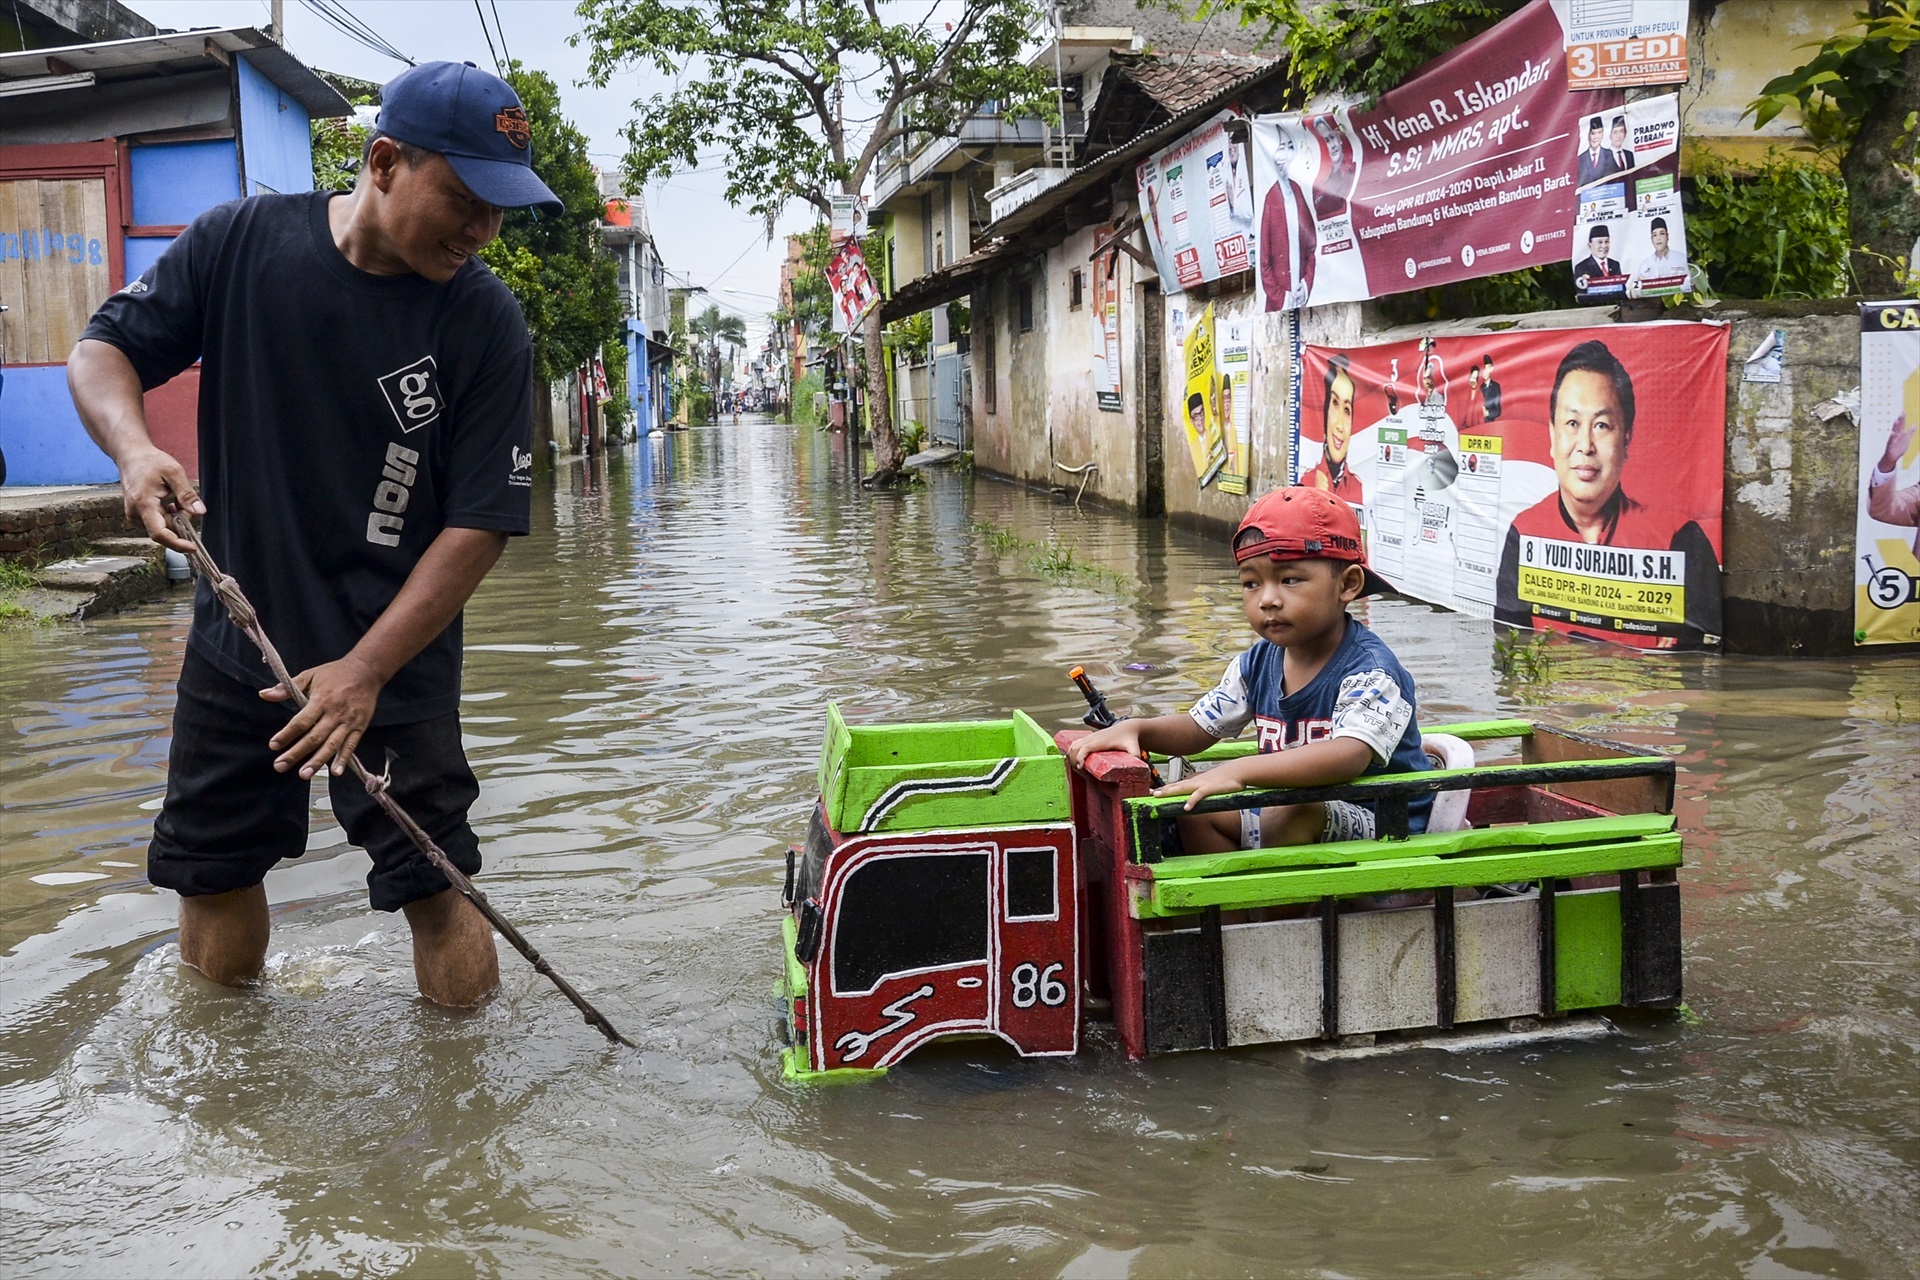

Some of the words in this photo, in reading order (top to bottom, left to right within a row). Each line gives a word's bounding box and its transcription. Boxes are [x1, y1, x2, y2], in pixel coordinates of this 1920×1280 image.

[1571, 32, 1594, 41] UNTUK
[1596, 27, 1628, 39] PROVINSI
[1630, 24, 1650, 35] LEBIH
[1652, 21, 1679, 33] PEDULI
[1604, 37, 1679, 62] TEDI
[1571, 46, 1595, 77] 3
[1605, 61, 1680, 76] SURAHMAN
[1383, 112, 1434, 141] Yena
[1430, 98, 1459, 125] R.
[1454, 57, 1551, 116] Iskandar,
[1634, 120, 1675, 136] PRABOWO
[1634, 131, 1664, 144] GIBRAN
[1386, 145, 1423, 178] S.Si,
[1426, 120, 1485, 165] MMRS,
[1487, 104, 1530, 146] apt.
[1374, 203, 1396, 217] Caleg
[1396, 196, 1414, 212] DPR
[1414, 192, 1425, 207] RI
[1425, 179, 1473, 204] 2024-2029
[1474, 169, 1505, 190] Dapil
[1505, 164, 1534, 182] Jabar
[1534, 157, 1546, 173] II
[1359, 222, 1397, 240] Kabupaten
[1397, 213, 1434, 230] Bandung
[1433, 207, 1440, 221] &
[1441, 196, 1497, 219] Kabupaten
[1498, 184, 1542, 205] Bandung
[1181, 250, 1195, 265] NIA
[1216, 243, 1225, 267] 3
[1223, 236, 1245, 258] TEDI
[1391, 359, 1398, 382] 3
[1468, 438, 1481, 449] DPR
[1484, 440, 1492, 450] RI
[1462, 454, 1467, 470] 3
[1423, 528, 1437, 540] 2024
[1526, 541, 1534, 563] 8
[1545, 543, 1572, 569] YUDI
[1575, 547, 1638, 580] SURJADI,
[1642, 554, 1676, 580] S.H.
[1525, 573, 1553, 589] CALEG
[1556, 579, 1592, 597] DPR-RI
[1595, 585, 1622, 600] 2024
[1637, 590, 1672, 605] 2029
[1878, 575, 1900, 602] 5
[1618, 603, 1646, 613] BANDUNG
[1011, 961, 1067, 1009] 86
